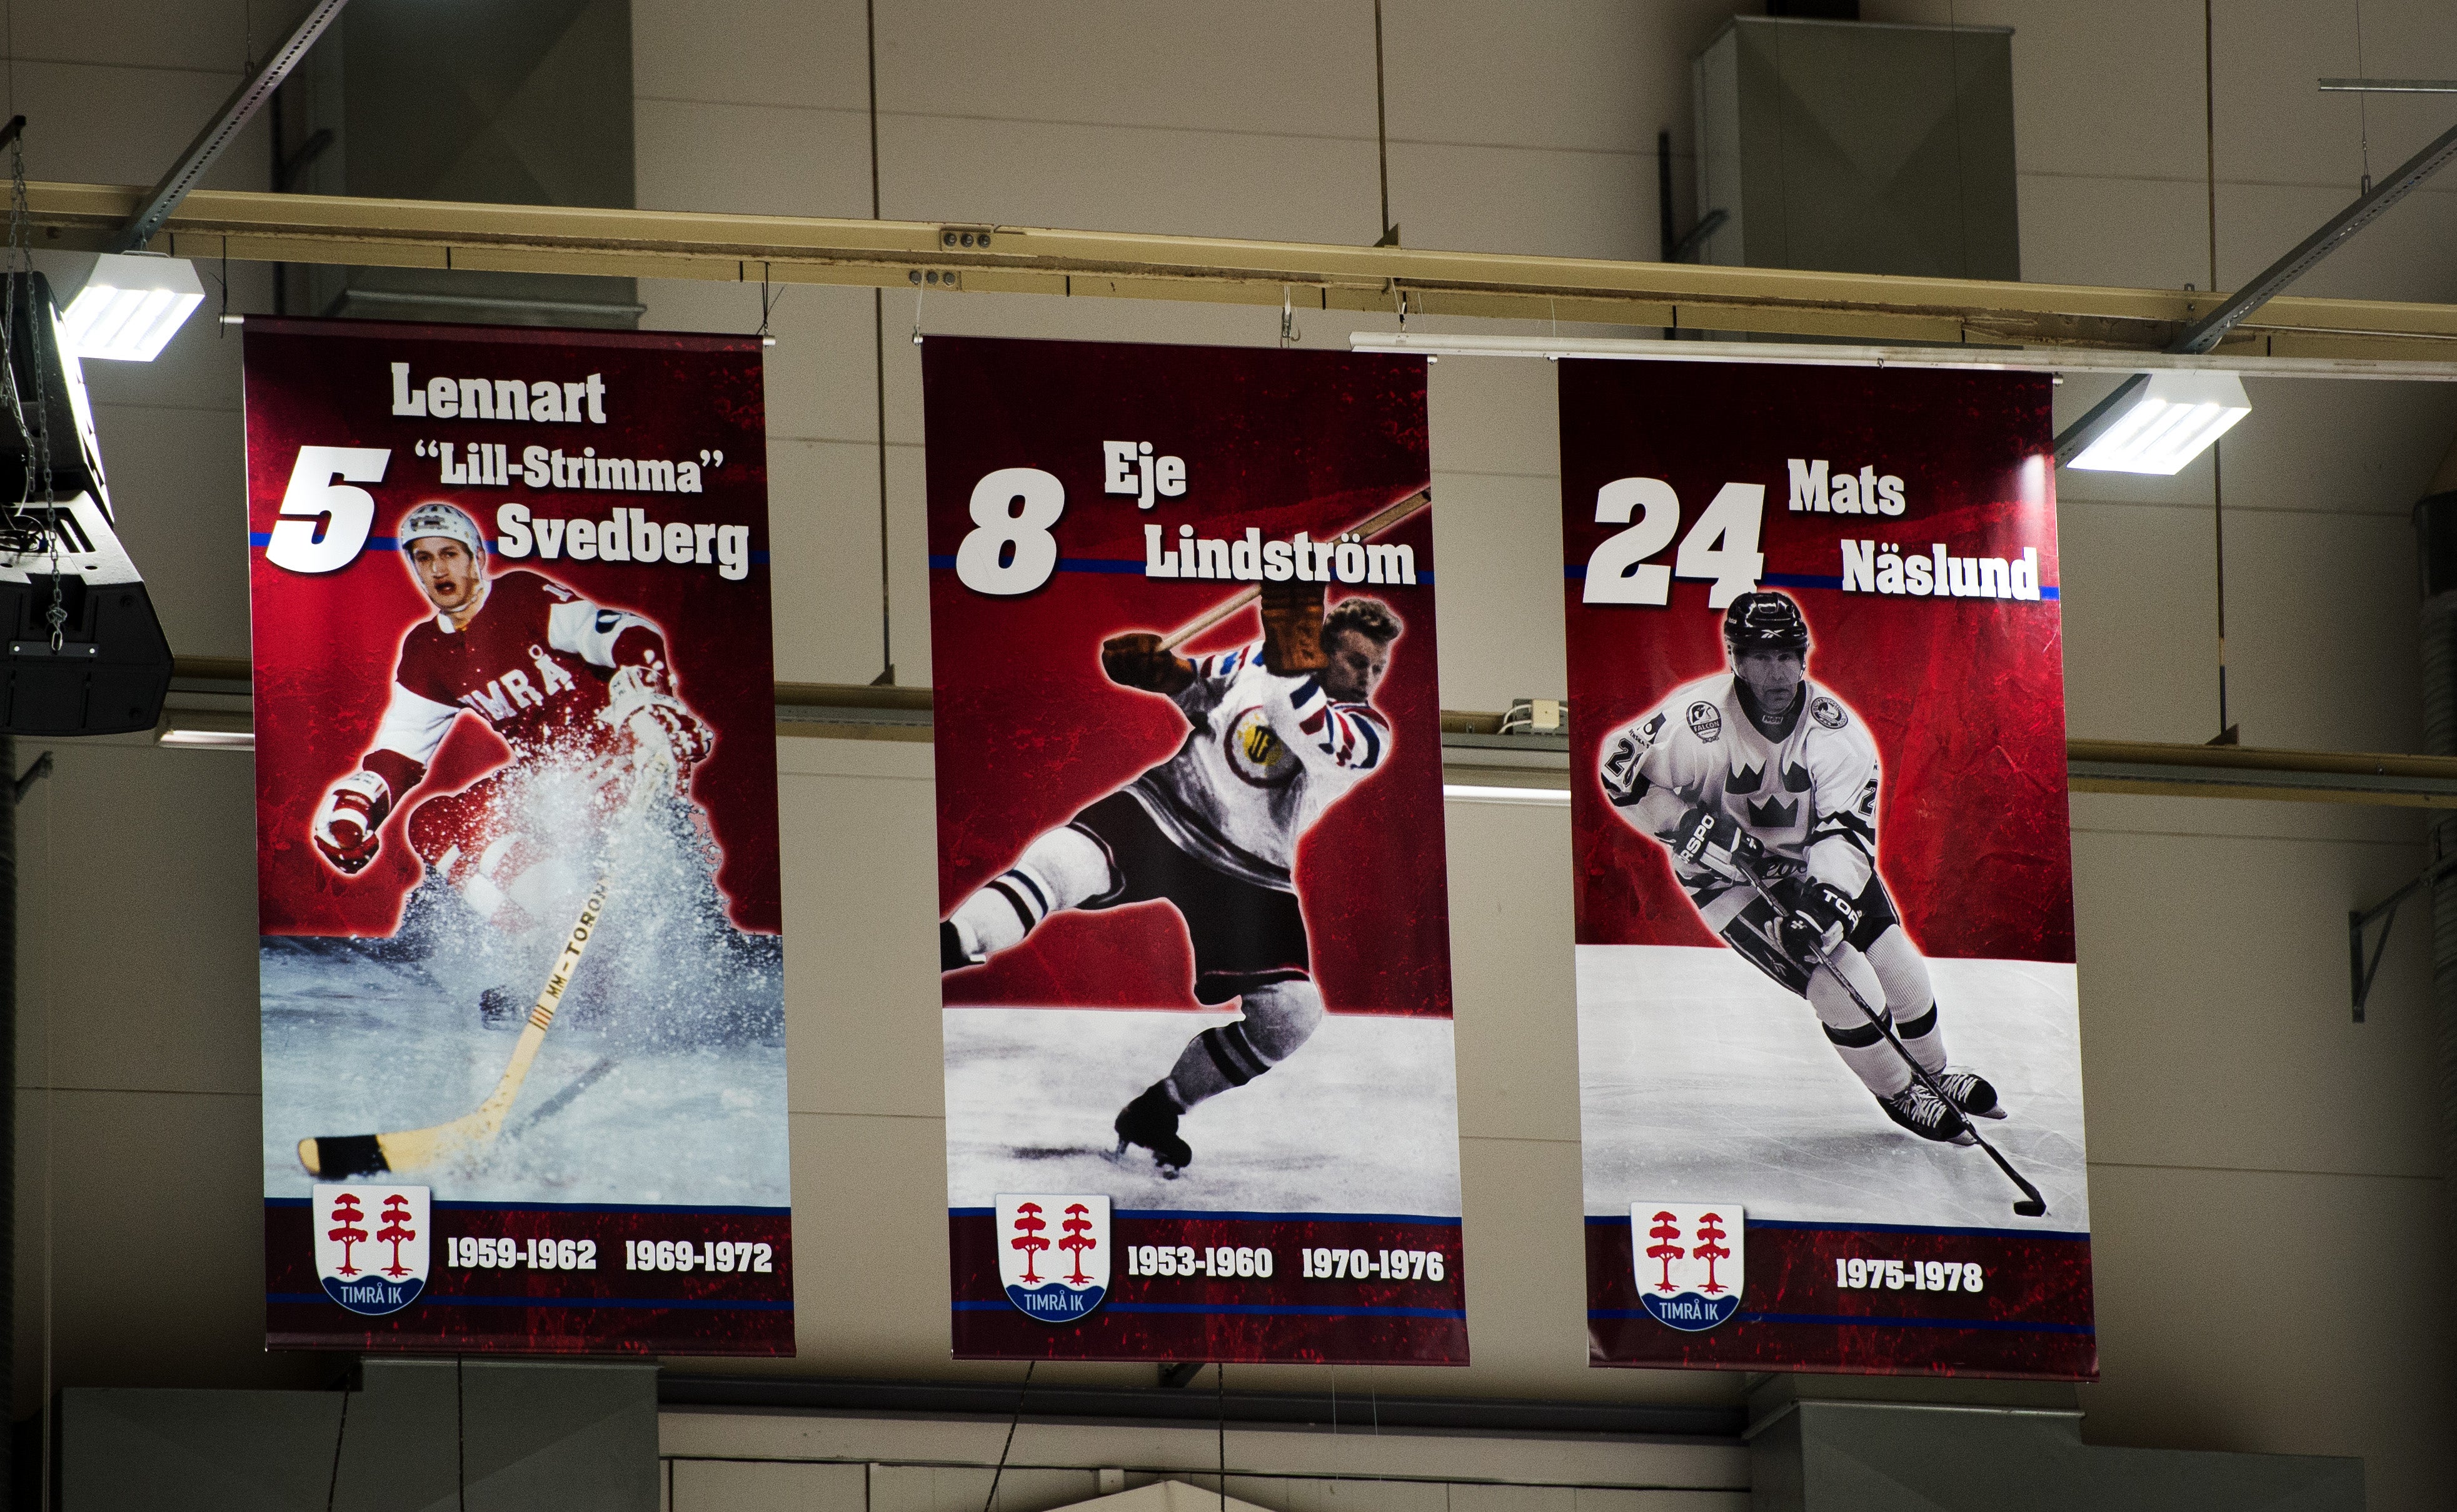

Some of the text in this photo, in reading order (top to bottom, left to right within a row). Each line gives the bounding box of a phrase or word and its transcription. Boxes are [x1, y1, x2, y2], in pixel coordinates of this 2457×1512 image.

[391, 362, 606, 424] Lennart
[415, 439, 723, 493] “Lill-Strimma”
[1103, 441, 1187, 509] Eje
[1787, 458, 1906, 516] Mats
[265, 445, 391, 573] 5
[956, 468, 1065, 595] 8
[496, 503, 749, 581] Svedberg
[1144, 523, 1417, 585] Lindström
[1582, 477, 1766, 608] 24
[1841, 539, 2041, 601] Näslund
[1693, 721, 1720, 733] FALCON
[1679, 814, 1715, 864] RSPO
[448, 1236, 773, 1273] 1959-1962 1969-1972
[1128, 1245, 1444, 1281] 1953-1960 1970-1976
[1836, 1258, 1984, 1293] 1975-1978
[340, 1282, 403, 1304] TIMRÅ IK
[1024, 1289, 1085, 1311] TIMRÅ IK
[1659, 1298, 1719, 1320] TIMRÅ IK
